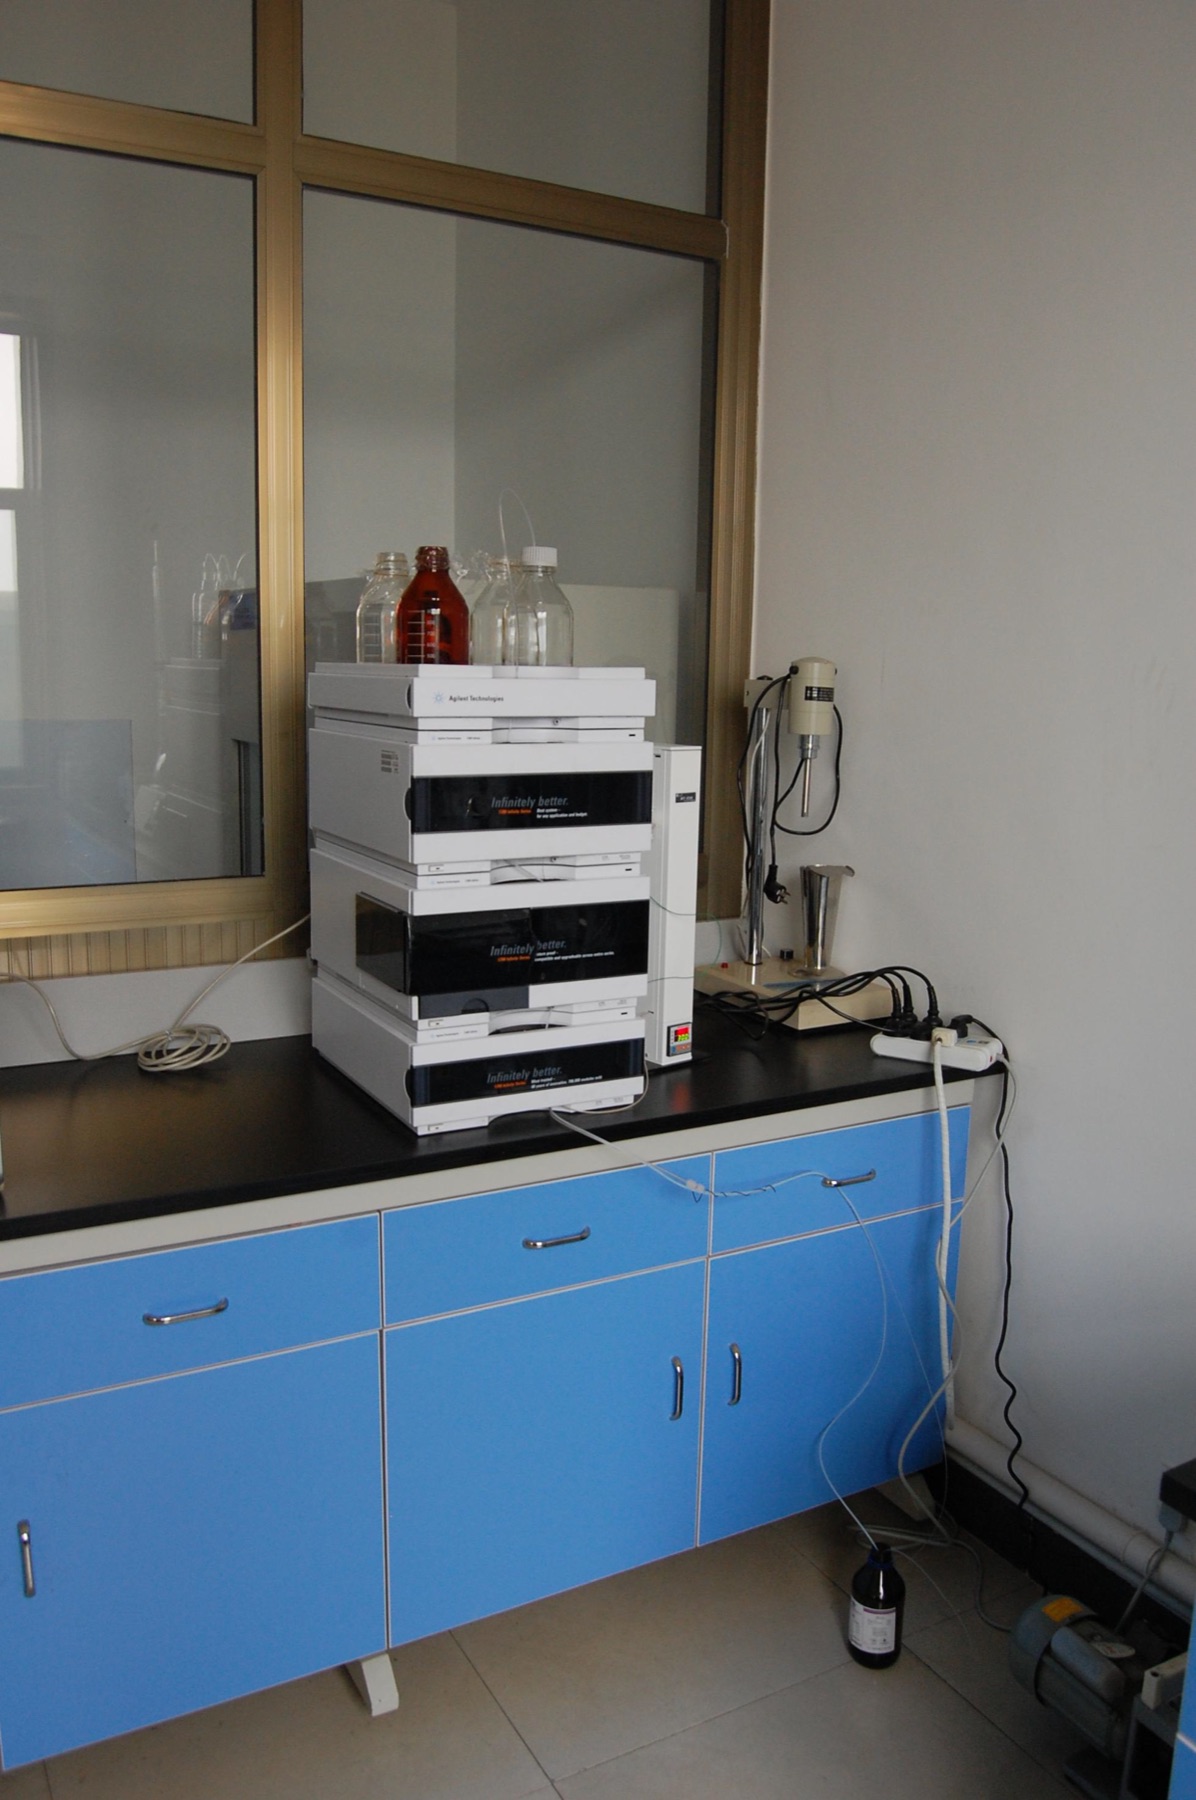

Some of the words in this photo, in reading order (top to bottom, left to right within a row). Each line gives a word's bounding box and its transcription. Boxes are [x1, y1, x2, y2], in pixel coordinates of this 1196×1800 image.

[470, 695, 504, 703] Technologies
[491, 797, 536, 809] Infinitely
[538, 796, 569, 807] better.
[490, 943, 535, 957] Infinitely
[536, 940, 567, 951] better.
[487, 1069, 531, 1084] Infinitely
[532, 1066, 562, 1078] better.
